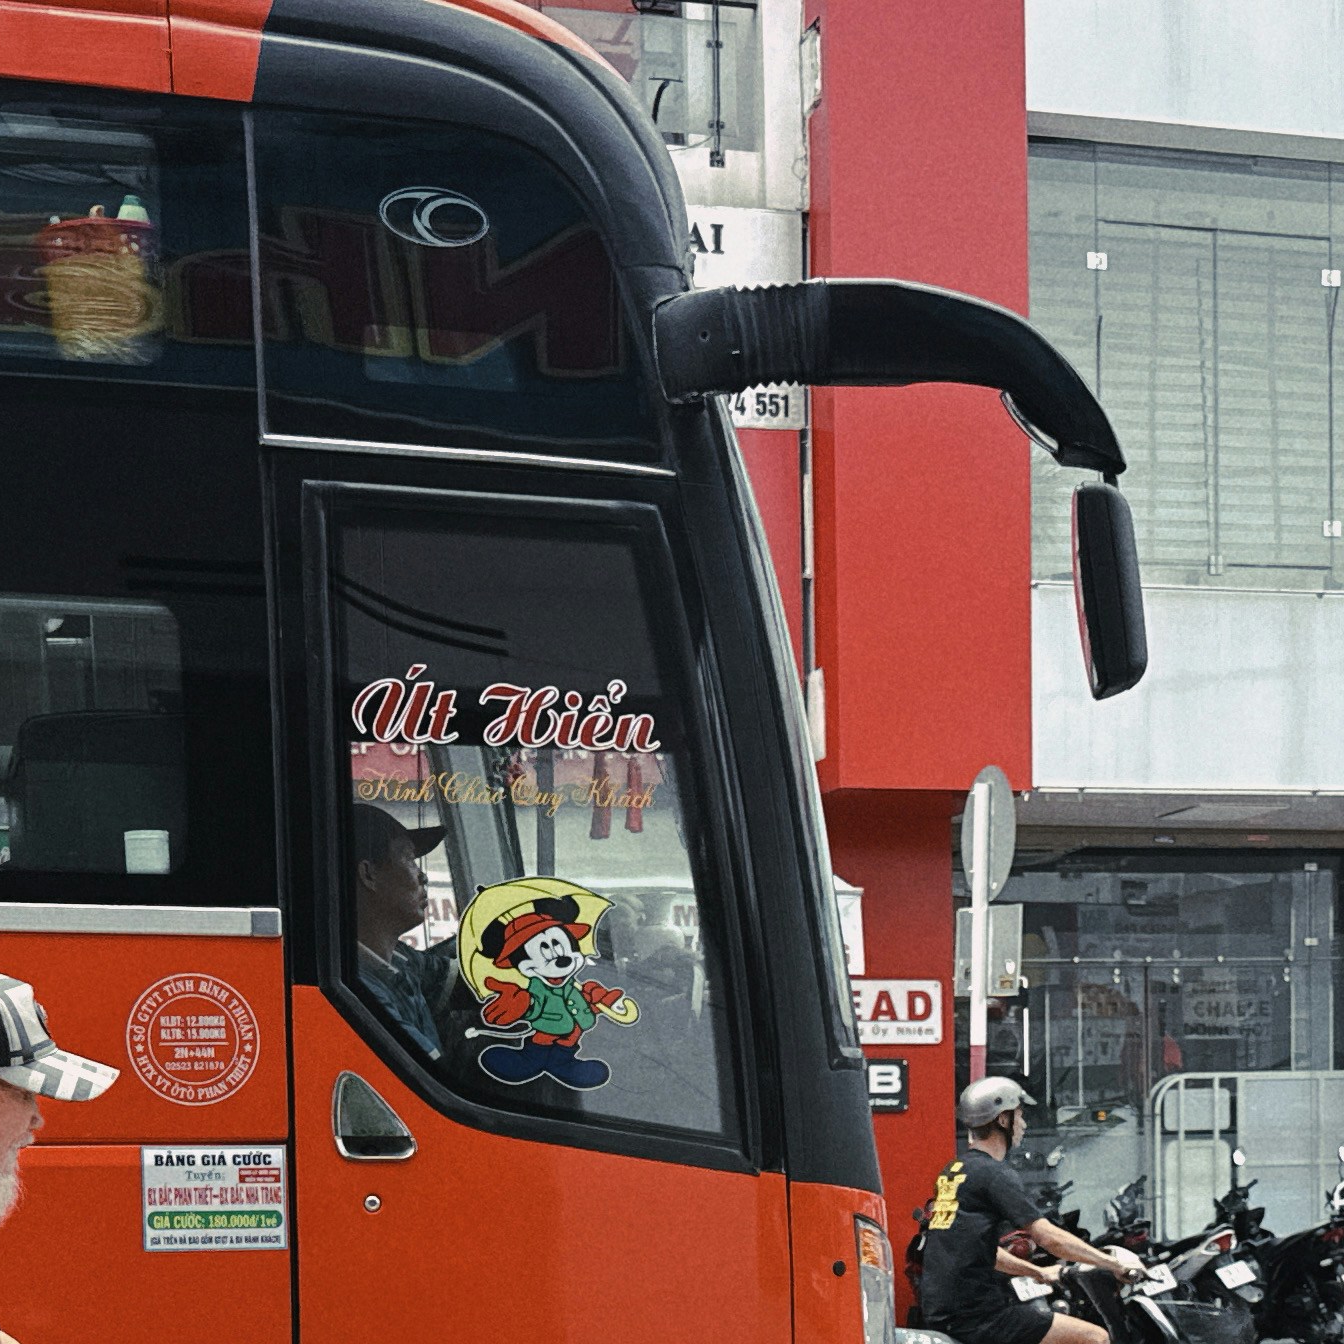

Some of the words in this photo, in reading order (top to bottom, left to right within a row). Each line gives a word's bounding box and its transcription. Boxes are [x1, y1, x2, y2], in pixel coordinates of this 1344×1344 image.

[756, 393, 789, 418] 551
[351, 664, 458, 743] Út
[479, 679, 661, 753] Hiển
[197, 1080, 229, 1100] PHAN
[154, 1150, 196, 1167] BẢNG
[201, 1151, 227, 1167] GIÁ
[232, 1151, 272, 1166] CƯỚC
